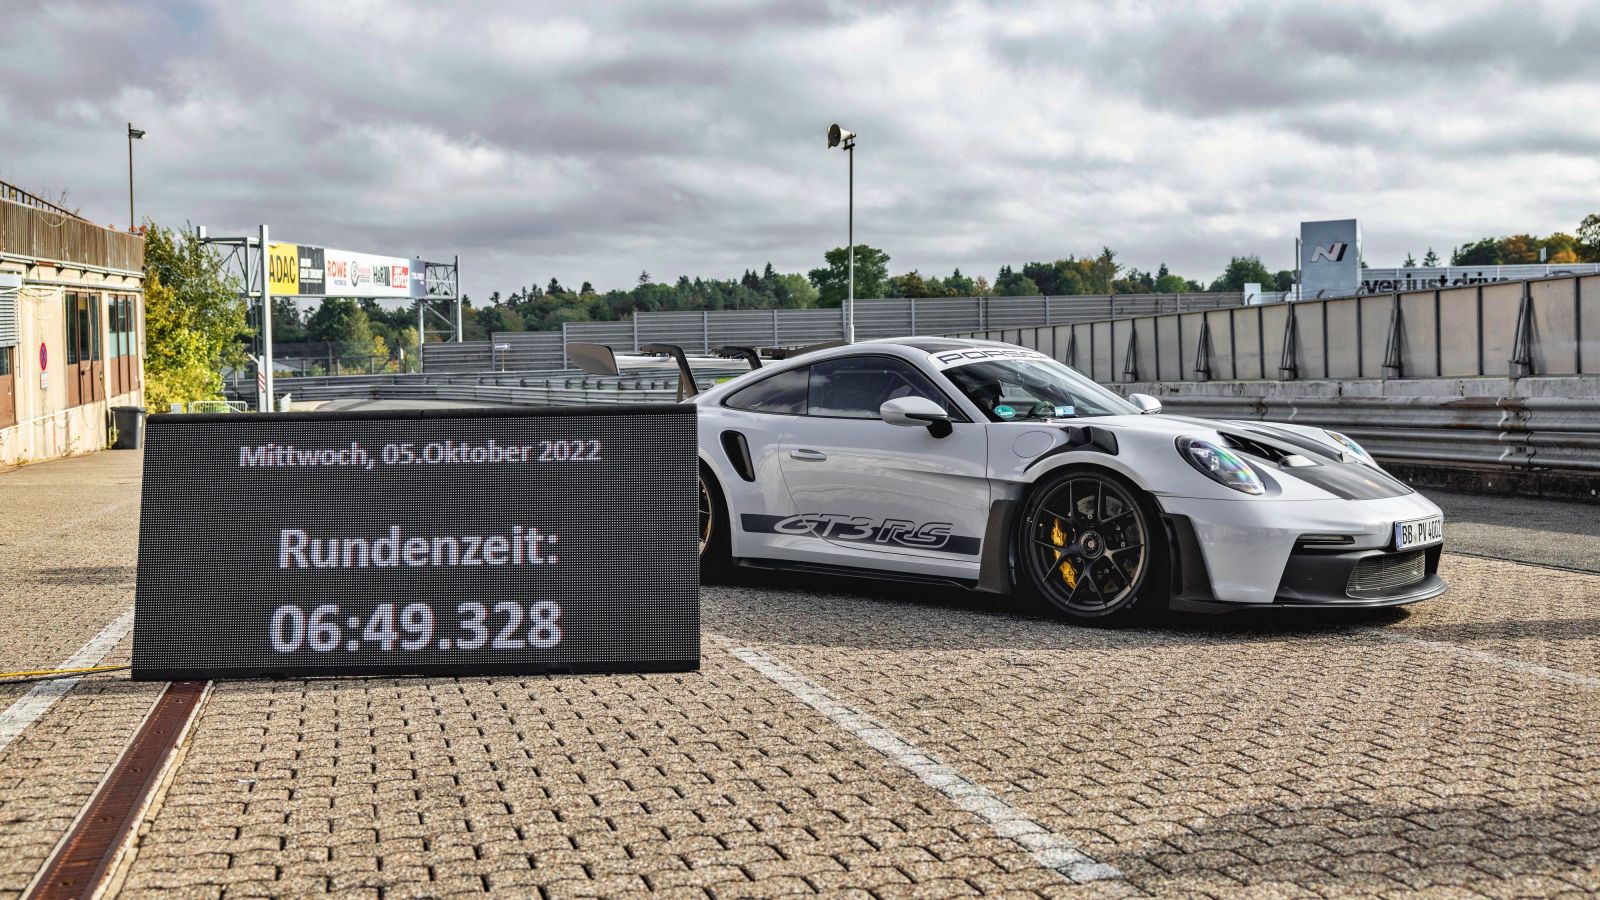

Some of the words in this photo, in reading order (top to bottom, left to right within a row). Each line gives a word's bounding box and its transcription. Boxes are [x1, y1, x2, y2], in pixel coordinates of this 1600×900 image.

[269, 254, 296, 284] ADAC
[327, 260, 347, 278] ROWE
[239, 442, 374, 469] Mittwoch,
[384, 440, 530, 464] 05.Oktober
[538, 440, 601, 461] 2022
[279, 526, 559, 568] Rundenzeit:
[1402, 525, 1412, 544] BB
[1418, 522, 1427, 542] PV
[270, 600, 565, 652] 06:49.328
